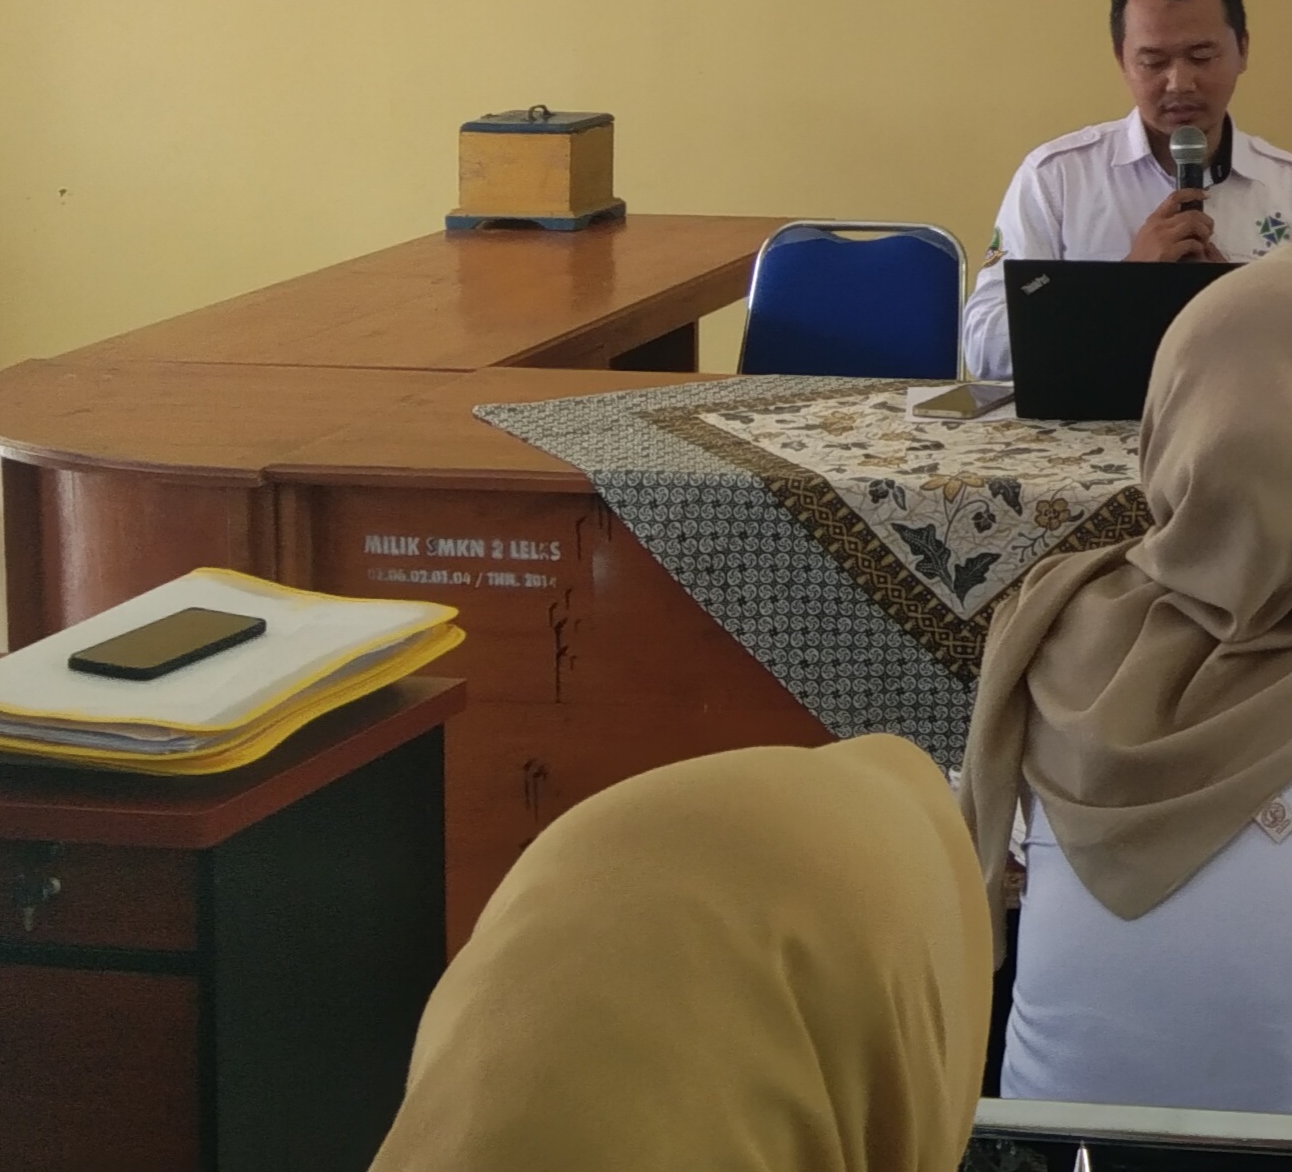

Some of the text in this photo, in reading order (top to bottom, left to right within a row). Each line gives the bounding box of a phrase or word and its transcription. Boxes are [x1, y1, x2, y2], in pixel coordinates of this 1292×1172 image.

[364, 534, 420, 557] MILIK
[426, 536, 485, 558] SMKN
[492, 540, 504, 559] 2
